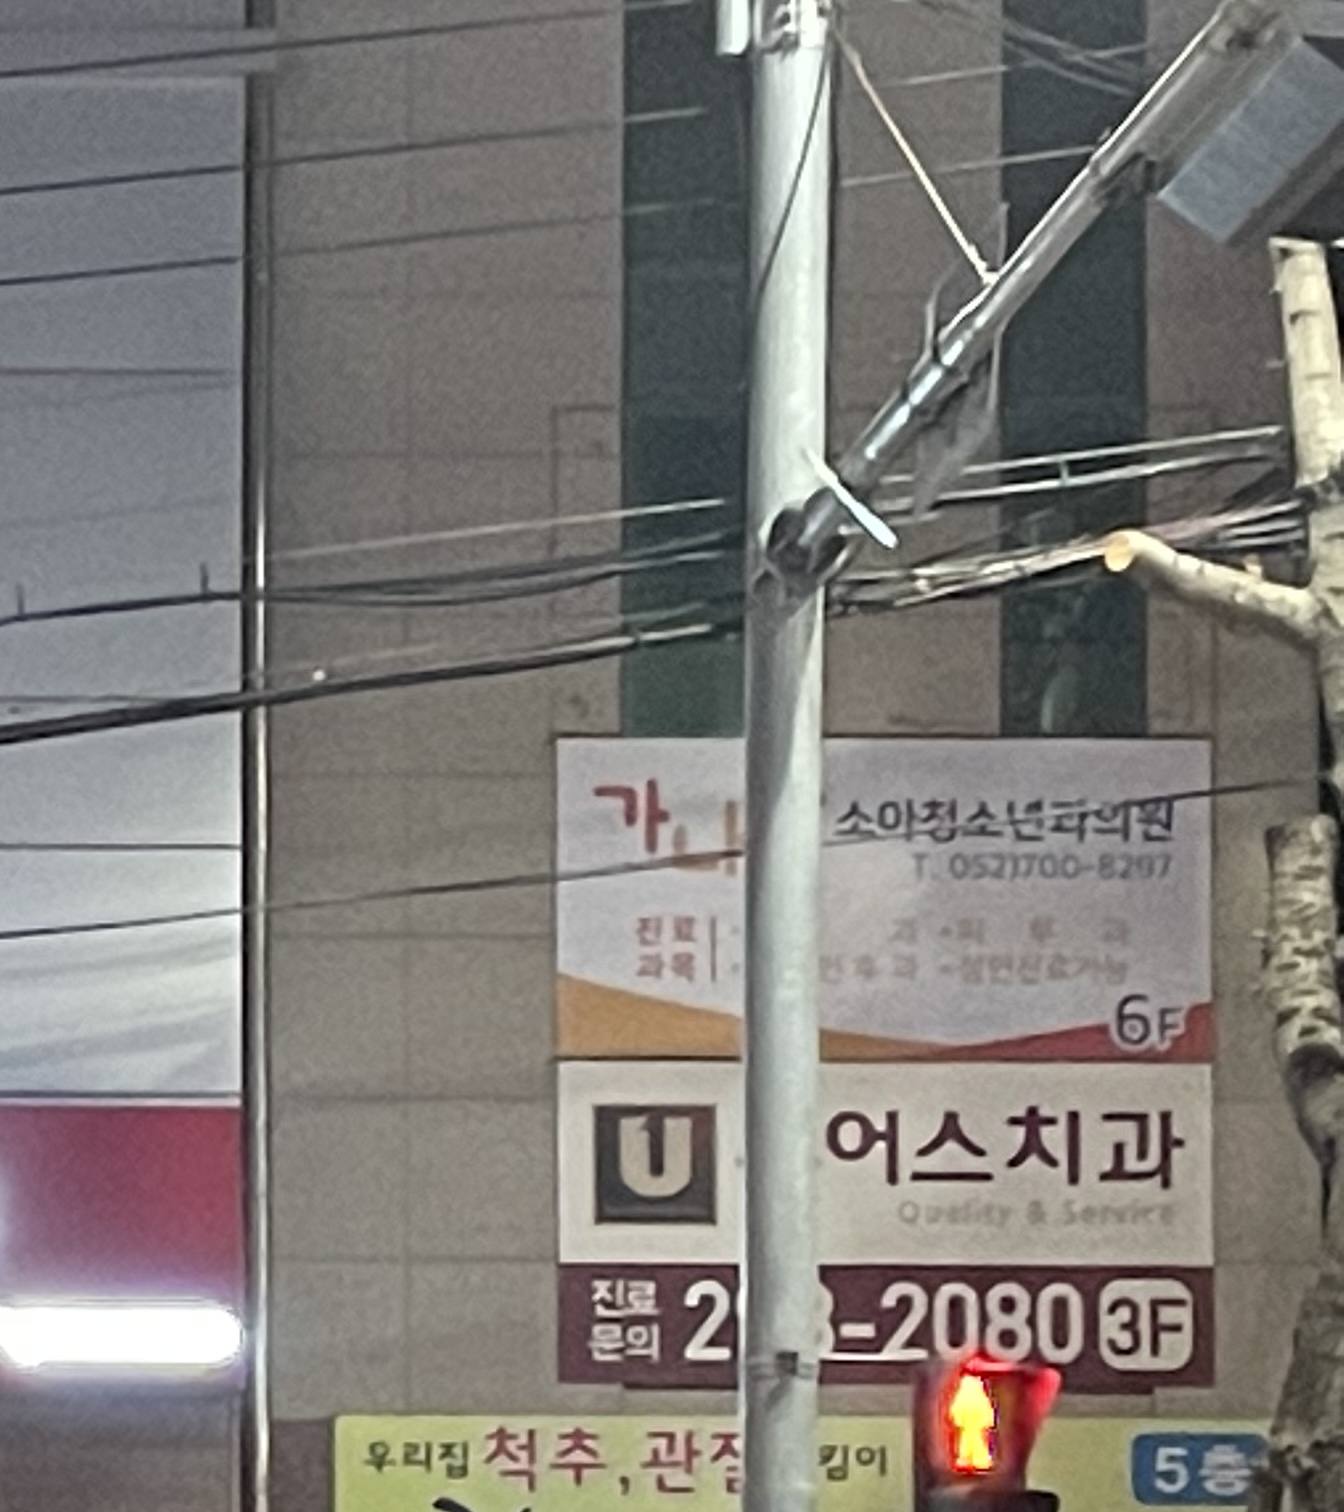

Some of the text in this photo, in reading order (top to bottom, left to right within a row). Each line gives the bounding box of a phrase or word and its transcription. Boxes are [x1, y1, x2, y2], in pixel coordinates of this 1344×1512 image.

[1116, 993, 1185, 1047] 6F
[816, 1106, 1186, 1190] 어스치과
[590, 1279, 662, 1320] 진료
[683, 1278, 1189, 1364] 2-2080 3F
[588, 1322, 662, 1364] 문의
[364, 1439, 471, 1480] 우리집
[818, 1442, 889, 1481] 킴이
